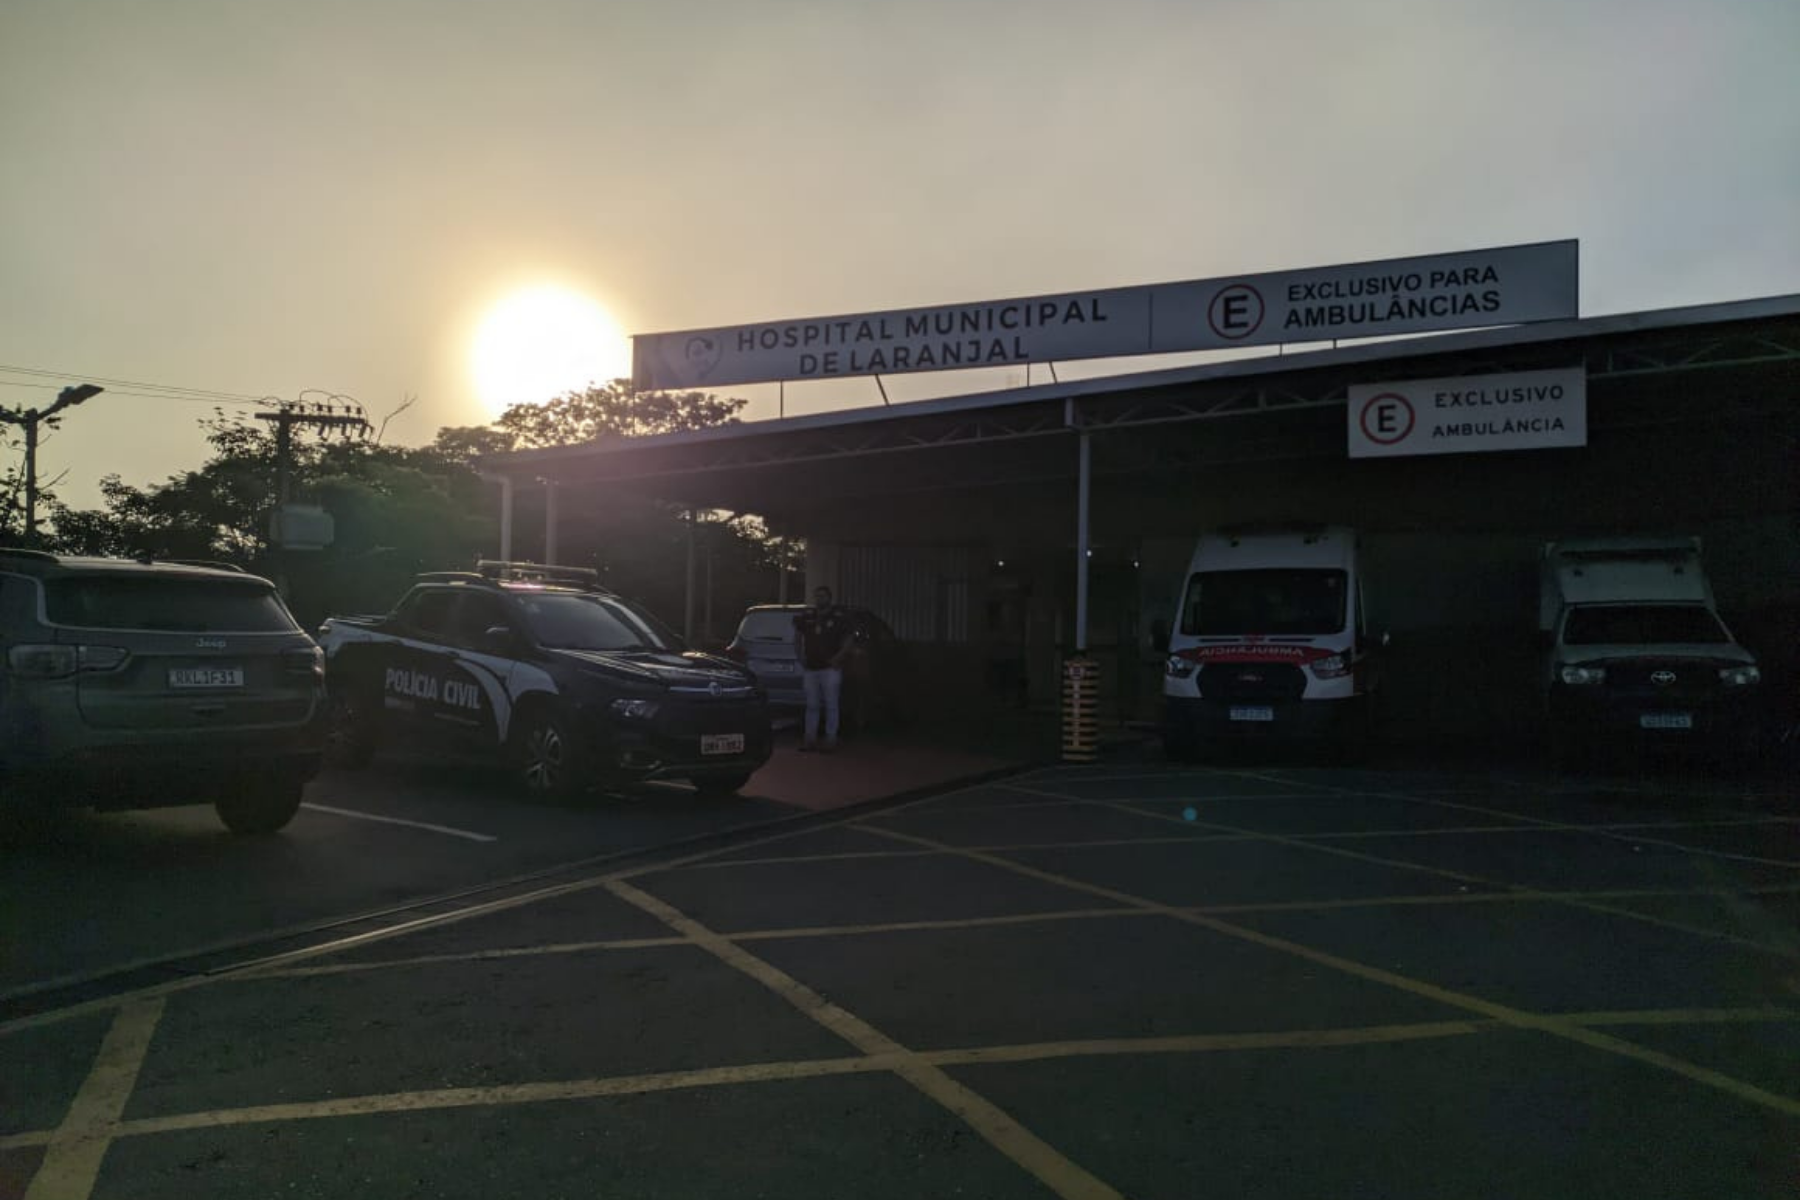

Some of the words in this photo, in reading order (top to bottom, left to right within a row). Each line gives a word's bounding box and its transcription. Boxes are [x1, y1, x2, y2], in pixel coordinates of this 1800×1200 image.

[1288, 274, 1422, 301] EXCLUSIVO
[1430, 266, 1499, 288] PARA
[738, 320, 894, 351] HOSPITAL
[905, 299, 1107, 338] MUNICIPAL
[1223, 294, 1249, 329] E
[1284, 290, 1501, 329] AMBULÂNCIAS
[801, 352, 839, 375] DE
[851, 337, 1030, 372] LARANJAL
[1435, 386, 1564, 409] EXCLUSIVO
[1378, 405, 1397, 432] E
[1433, 417, 1565, 438] AMBULÂNCIA
[444, 680, 481, 709] CIVIL
